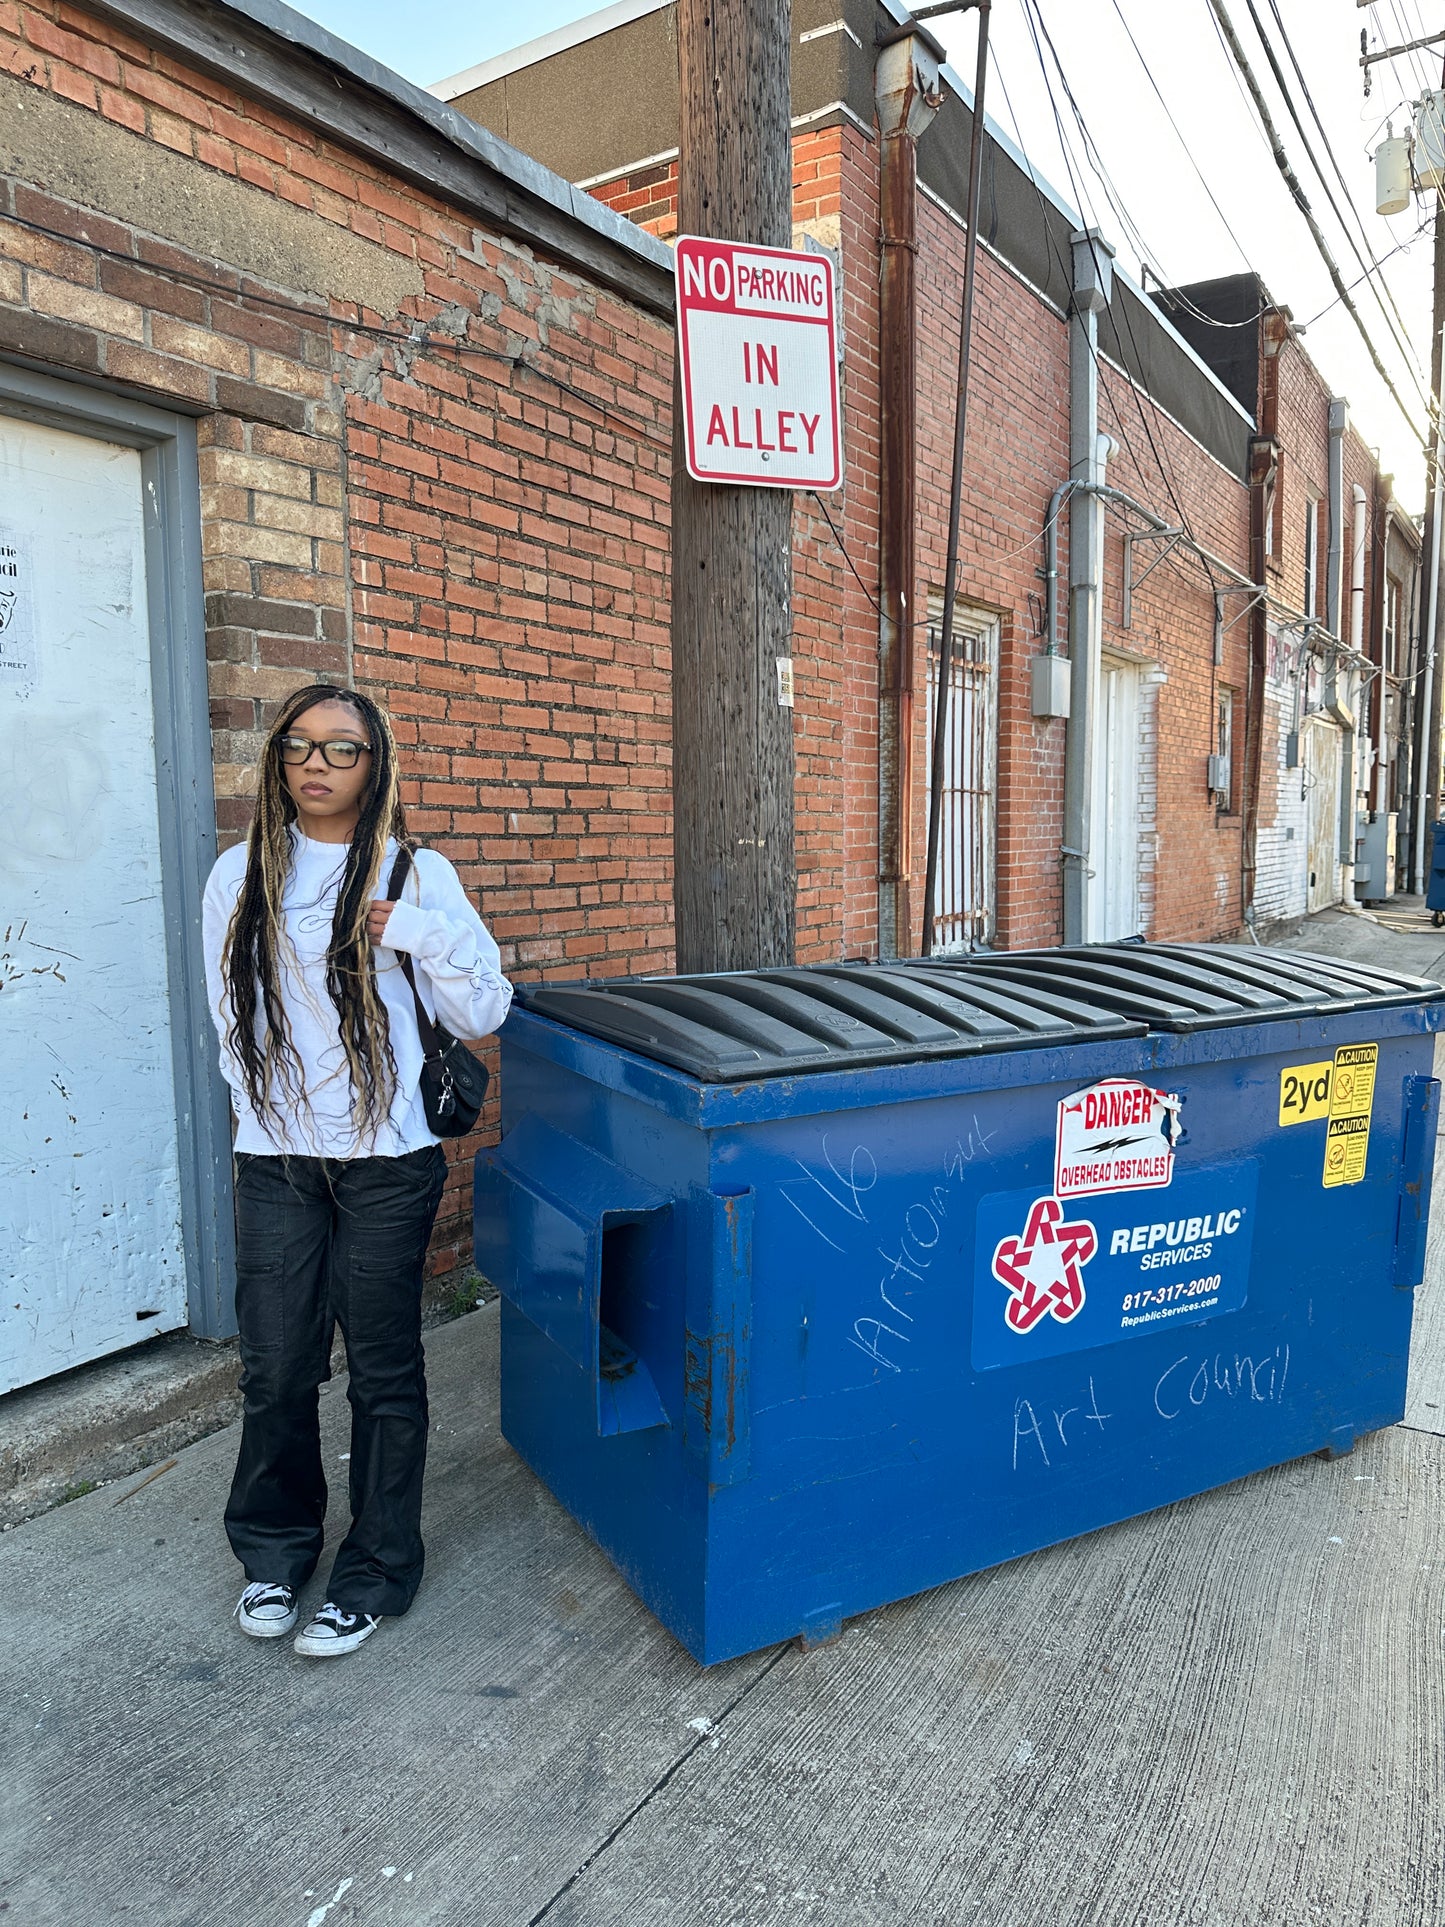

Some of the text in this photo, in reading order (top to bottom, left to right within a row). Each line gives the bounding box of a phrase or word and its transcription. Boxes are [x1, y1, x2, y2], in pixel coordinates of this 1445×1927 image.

[682, 253, 823, 307] NO PARKING
[743, 341, 779, 387] IN
[706, 403, 821, 455] ALLEY
[1345, 1048, 1376, 1064] CAUTION
[1084, 1087, 1153, 1130] DANGER
[1283, 1069, 1330, 1114] 2yd
[1337, 1117, 1369, 1134] CAUTION
[1061, 1156, 1166, 1188] OVERHEAD OBSTACLES
[1109, 1208, 1242, 1256] REPUBLIC
[1140, 1241, 1213, 1271] SERVICES
[1120, 1296, 1219, 1328] RepublicServices.com
[1121, 1273, 1222, 1312] 817-317-2000
[1013, 1375, 1113, 1471] Art
